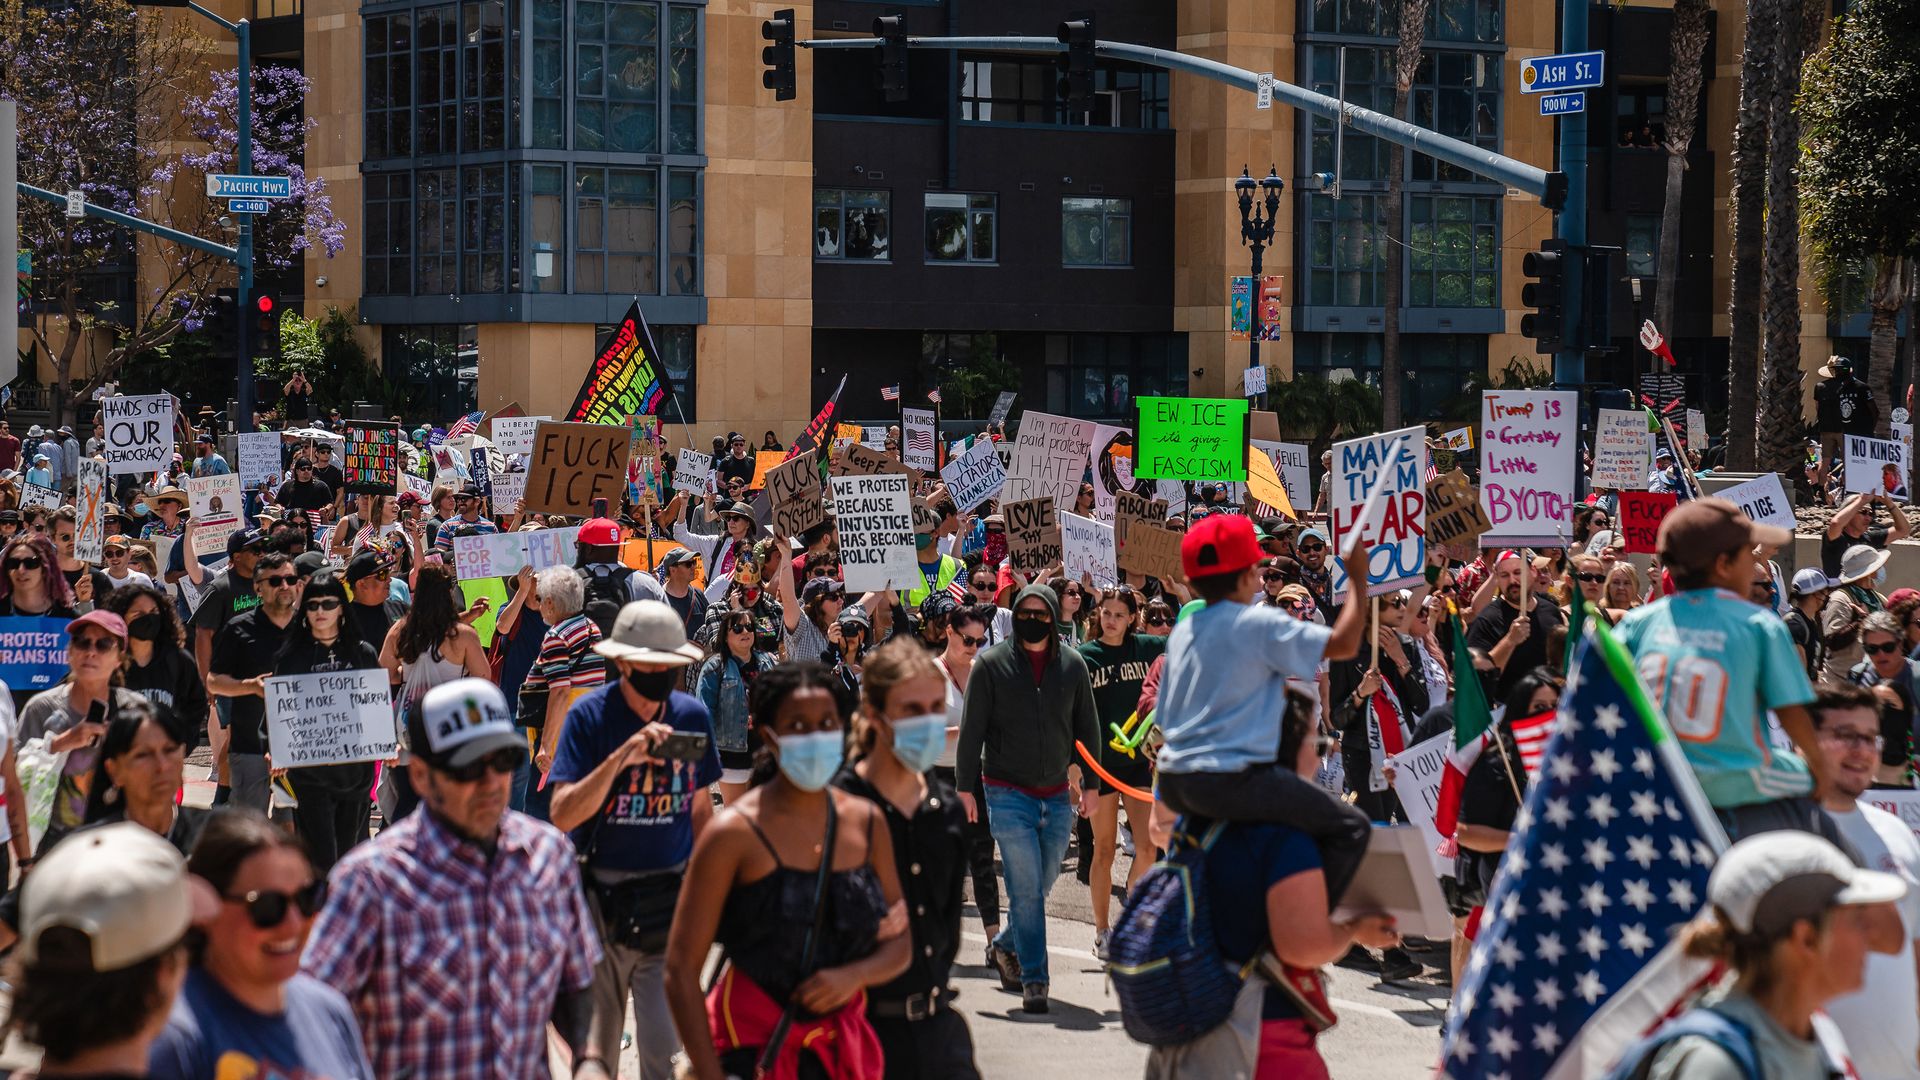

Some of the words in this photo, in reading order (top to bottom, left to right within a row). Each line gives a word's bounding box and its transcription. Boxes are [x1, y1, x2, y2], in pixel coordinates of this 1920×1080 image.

[246, 202, 264, 211] 1400
[104, 400, 142, 418] HANDS
[1191, 403, 1226, 426] ICE
[1485, 395, 1534, 422] Trump
[904, 414, 914, 424] NO
[915, 415, 935, 427] KINGS
[1049, 418, 1067, 436] not
[1071, 424, 1080, 436] a
[110, 421, 160, 447] OUR
[353, 429, 365, 442] NO
[346, 442, 358, 455] NO
[541, 433, 623, 470] FUCK
[1019, 432, 1045, 451] paid
[1048, 438, 1092, 458] protester
[1343, 435, 1415, 473] MAKE
[1851, 438, 1866, 458] NO
[1870, 441, 1902, 463] KINGS
[106, 447, 167, 464] DEMOCRACY
[346, 455, 358, 468] NO
[682, 450, 709, 466] DUMP
[904, 454, 921, 465] SINCE
[922, 456, 935, 466] 1776
[957, 451, 976, 473] NO
[1488, 451, 1538, 475] Little
[353, 468, 364, 481] NO
[946, 450, 1000, 498] DICTATORS
[1030, 455, 1079, 483] HATE
[1153, 456, 1232, 479] FASCISM
[544, 467, 613, 507] ICE
[674, 471, 704, 489] DICTATOR
[773, 459, 817, 502] FUCK
[833, 482, 854, 495] WE
[859, 479, 907, 494] PROTEST
[1345, 470, 1418, 502] THEM
[212, 488, 233, 496] BEAR
[1006, 478, 1074, 508] TRUMP
[837, 498, 895, 515] BECAUSE
[1117, 495, 1168, 521] ABOLISH
[1485, 483, 1574, 524] BYOTCH
[1628, 500, 1670, 520] FUCK
[1753, 496, 1777, 519] ICE
[838, 515, 909, 532] INJUSTICE
[1334, 491, 1424, 559] HEAR
[460, 536, 484, 551] GO
[840, 533, 867, 549] HAS
[869, 532, 915, 548] BECOME
[1019, 528, 1042, 545] THY
[456, 549, 491, 565] FOR
[841, 548, 886, 565] POLICY
[1334, 536, 1424, 590] YOU
[457, 563, 492, 579] THE
[271, 680, 303, 694] THE
[319, 677, 368, 693] PEOPLE
[277, 697, 302, 714] ARE
[305, 694, 336, 709] MORE
[280, 716, 316, 730] THAN
[322, 712, 350, 724] THE
[291, 750, 308, 762] NO
[352, 744, 373, 757] FUCK
[1403, 749, 1439, 781] YOU
